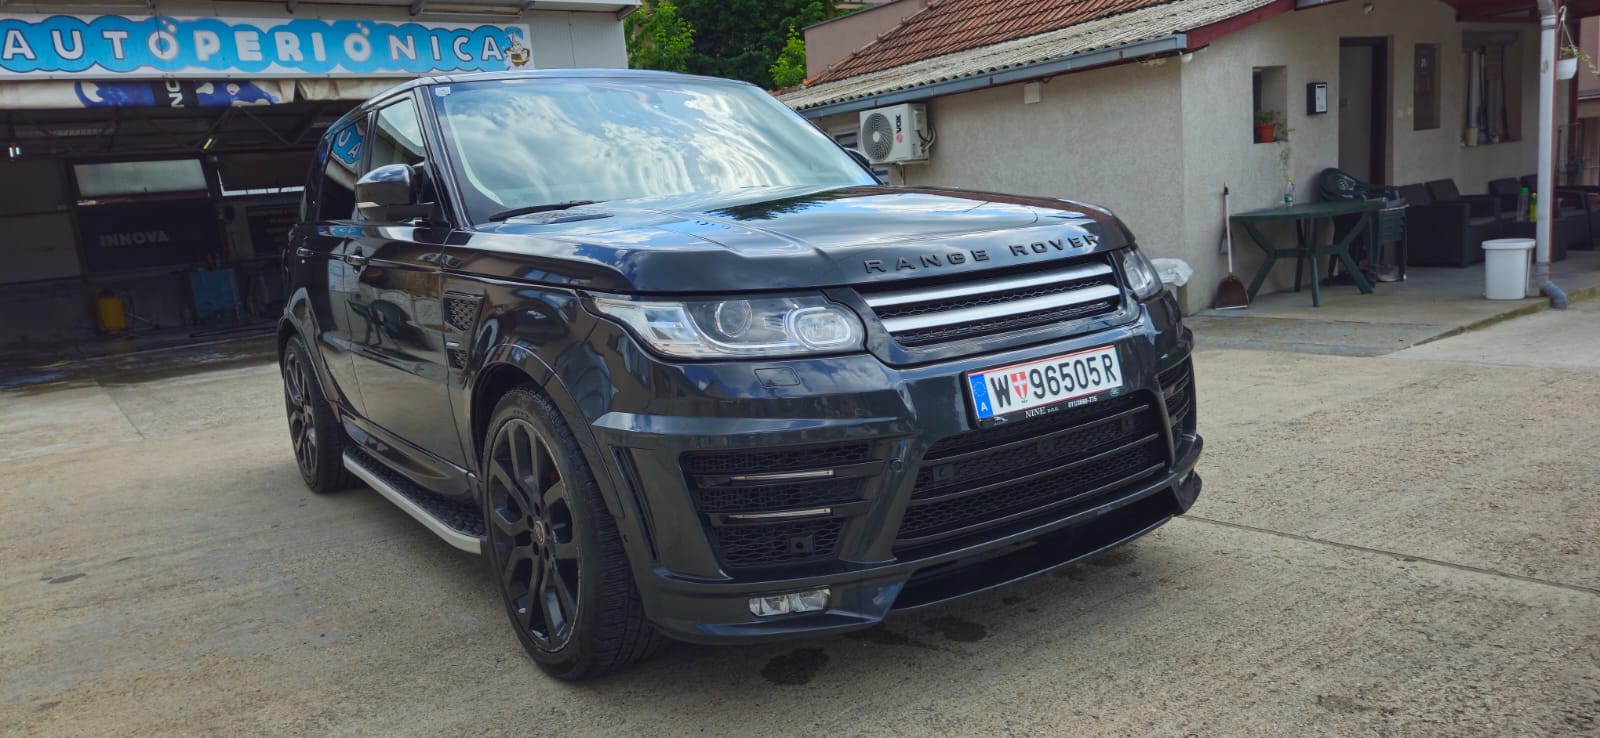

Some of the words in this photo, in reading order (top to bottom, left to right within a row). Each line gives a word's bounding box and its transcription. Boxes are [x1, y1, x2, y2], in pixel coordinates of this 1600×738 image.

[1, 27, 503, 63] AUTOPERIONICA
[99, 230, 169, 248] INNOVA
[863, 249, 991, 274] RANGE
[1008, 233, 1100, 257] ROVER
[990, 375, 1011, 408] W
[981, 402, 989, 412] A
[1025, 406, 1047, 418] NINE
